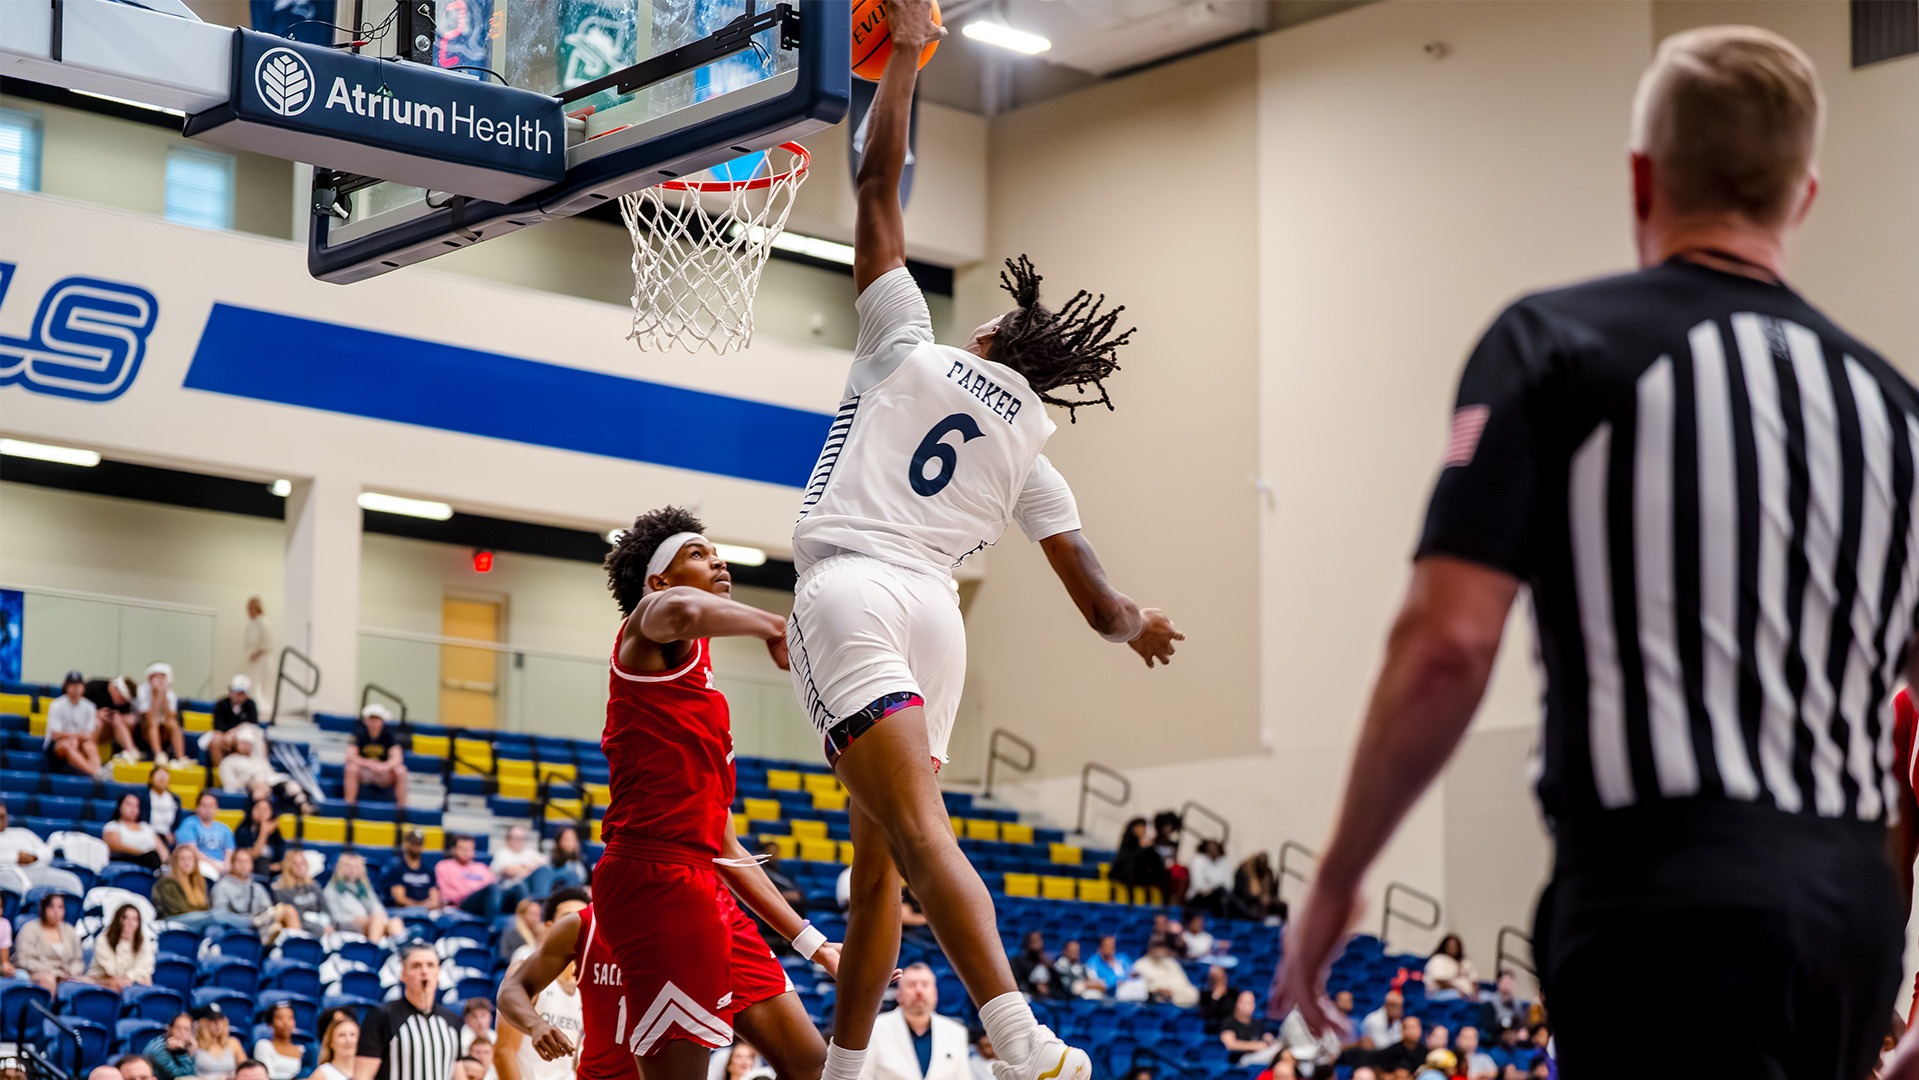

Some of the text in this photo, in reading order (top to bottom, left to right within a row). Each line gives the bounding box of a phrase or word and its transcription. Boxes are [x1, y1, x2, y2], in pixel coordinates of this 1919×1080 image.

[325, 76, 552, 154] Atrium Health
[946, 360, 1022, 425] PARKER
[908, 412, 986, 497] 6
